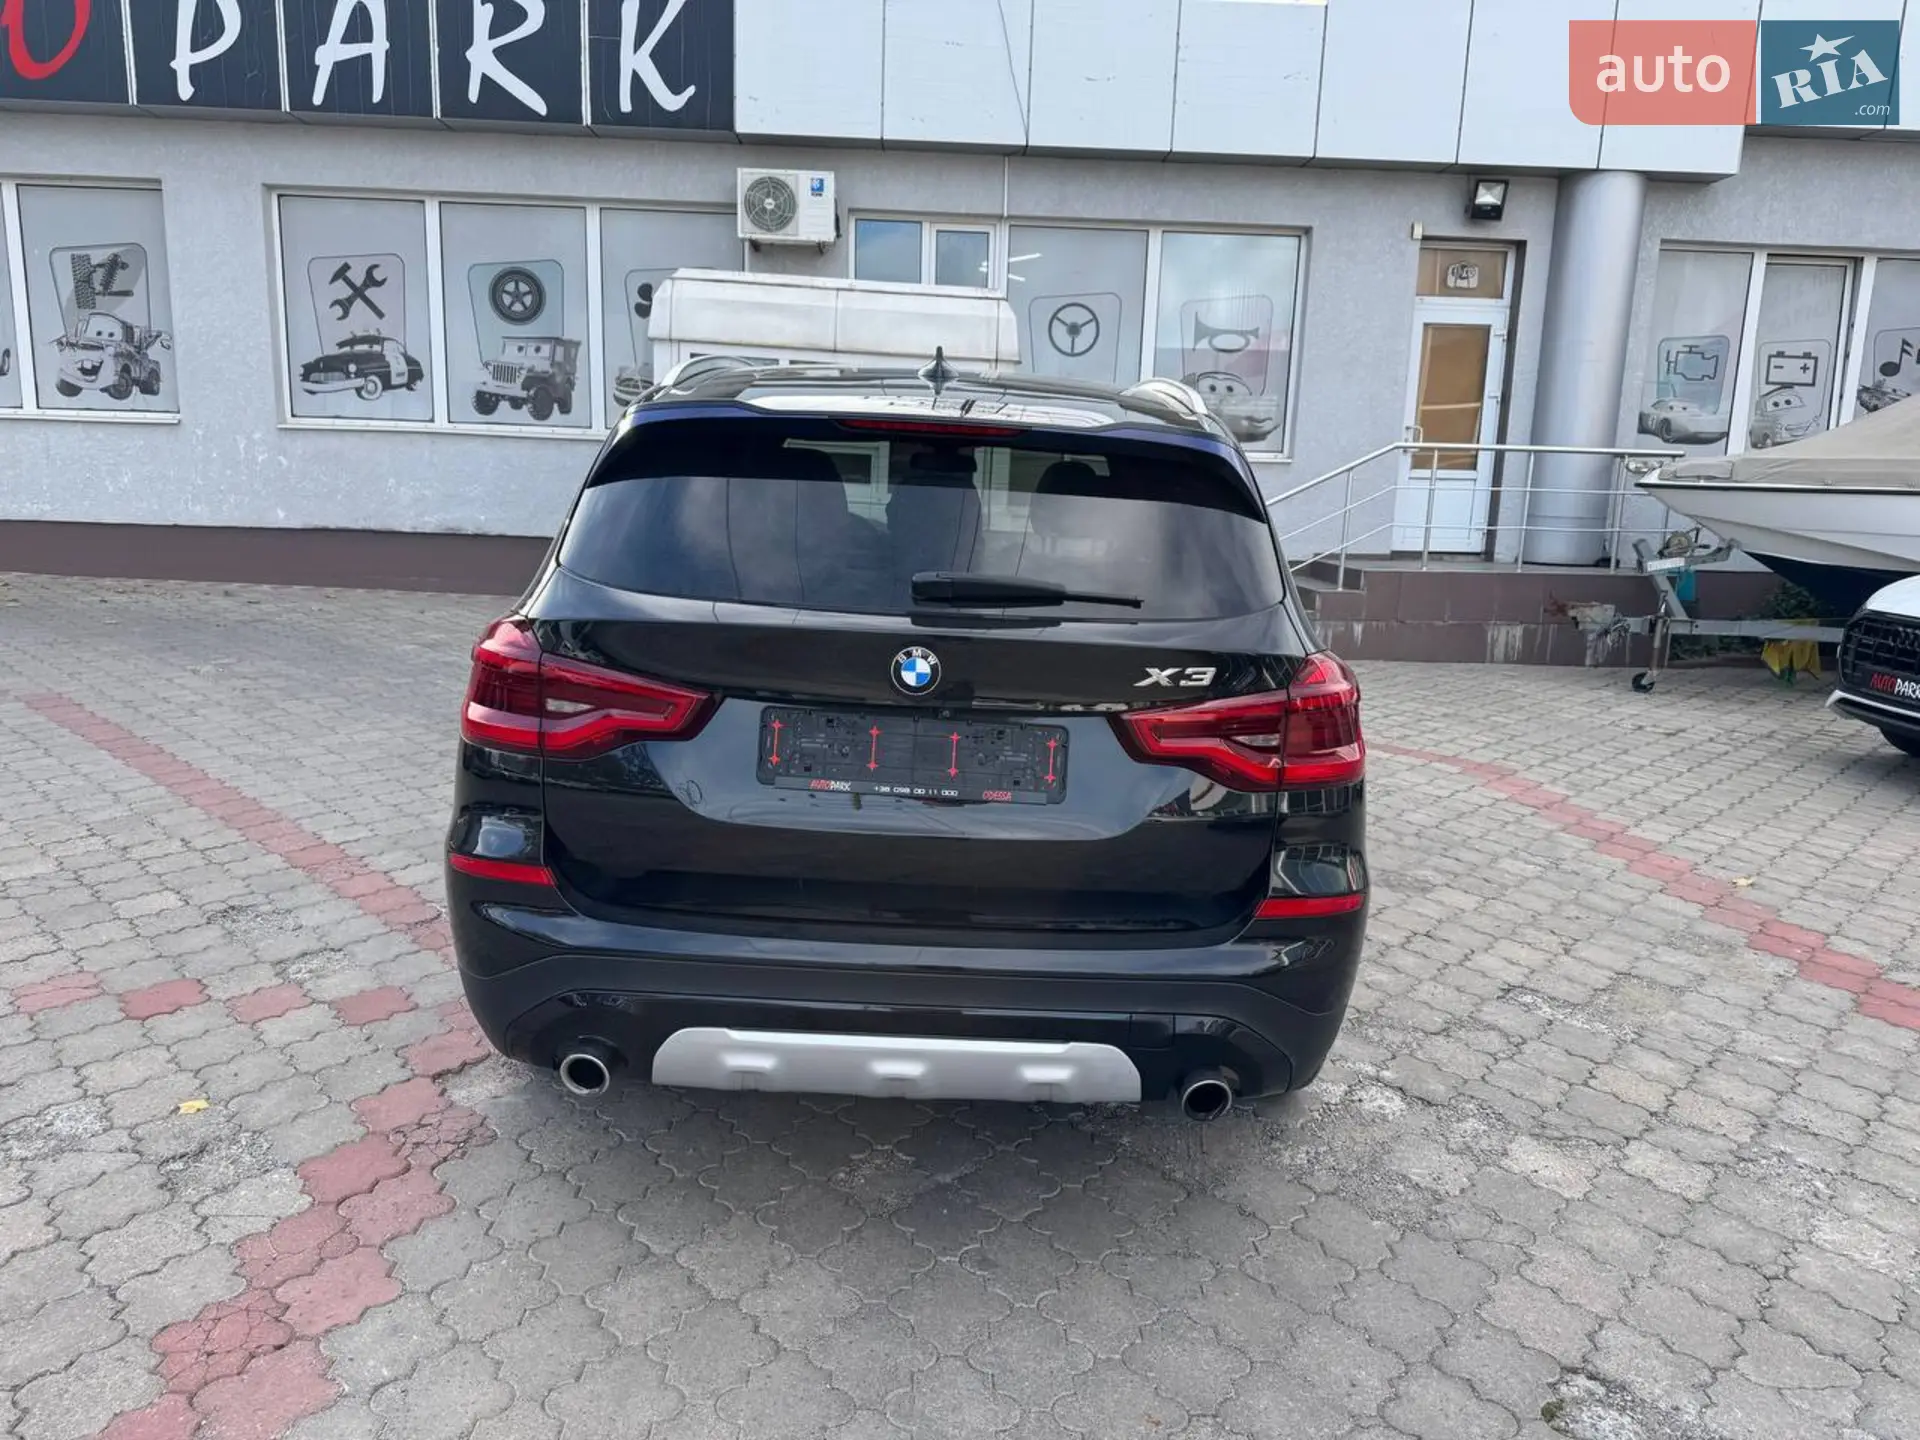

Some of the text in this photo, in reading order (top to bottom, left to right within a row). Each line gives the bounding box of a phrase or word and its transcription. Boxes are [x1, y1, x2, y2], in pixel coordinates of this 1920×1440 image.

[896, 648, 938, 666] BMW
[1133, 666, 1217, 687] X3
[874, 785, 890, 793] +38
[913, 787, 926, 795] 00
[929, 788, 938, 796] 11
[941, 789, 958, 797] 000
